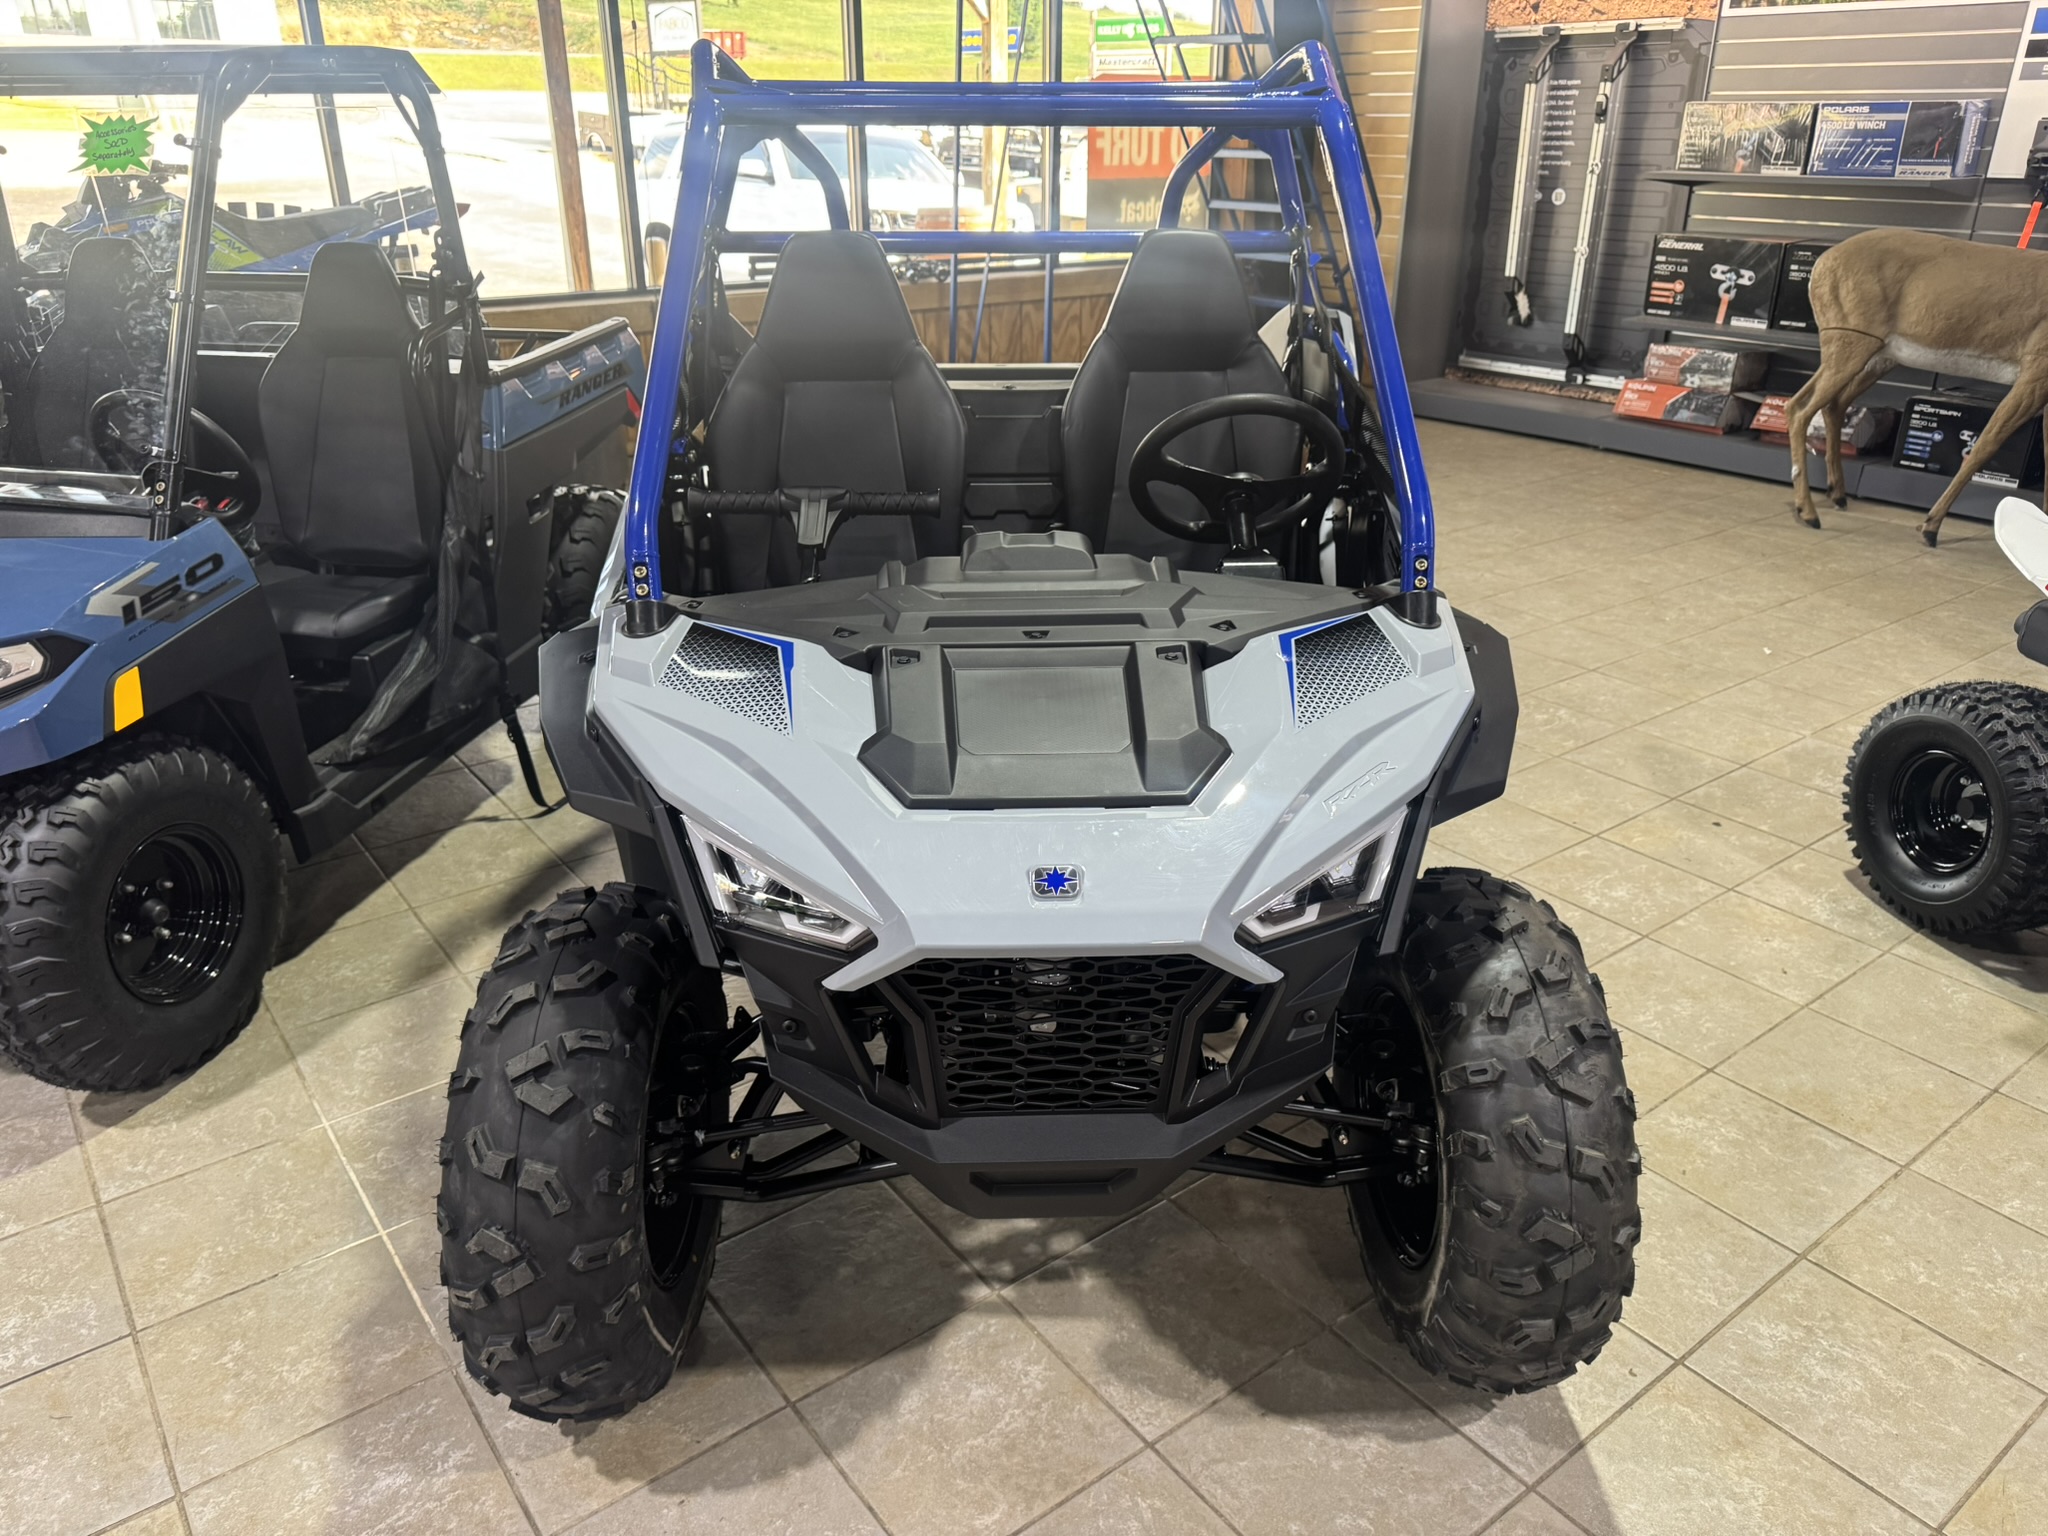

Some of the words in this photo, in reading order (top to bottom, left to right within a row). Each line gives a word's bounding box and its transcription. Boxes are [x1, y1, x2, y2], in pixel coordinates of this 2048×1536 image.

[1098, 57, 1156, 67] Mastercraft
[1822, 105, 1870, 113] POLARIS
[1843, 121, 1855, 129] LB
[1857, 121, 1887, 130] WINCH
[95, 124, 137, 139] Accessories
[1657, 241, 1704, 251] GENERAL
[558, 362, 625, 408] RANGER
[1627, 382, 1657, 392] KOLPIN
[1765, 397, 1785, 406] KOL
[1913, 405, 1962, 417] SPORTSMAN
[121, 552, 225, 627] 150
